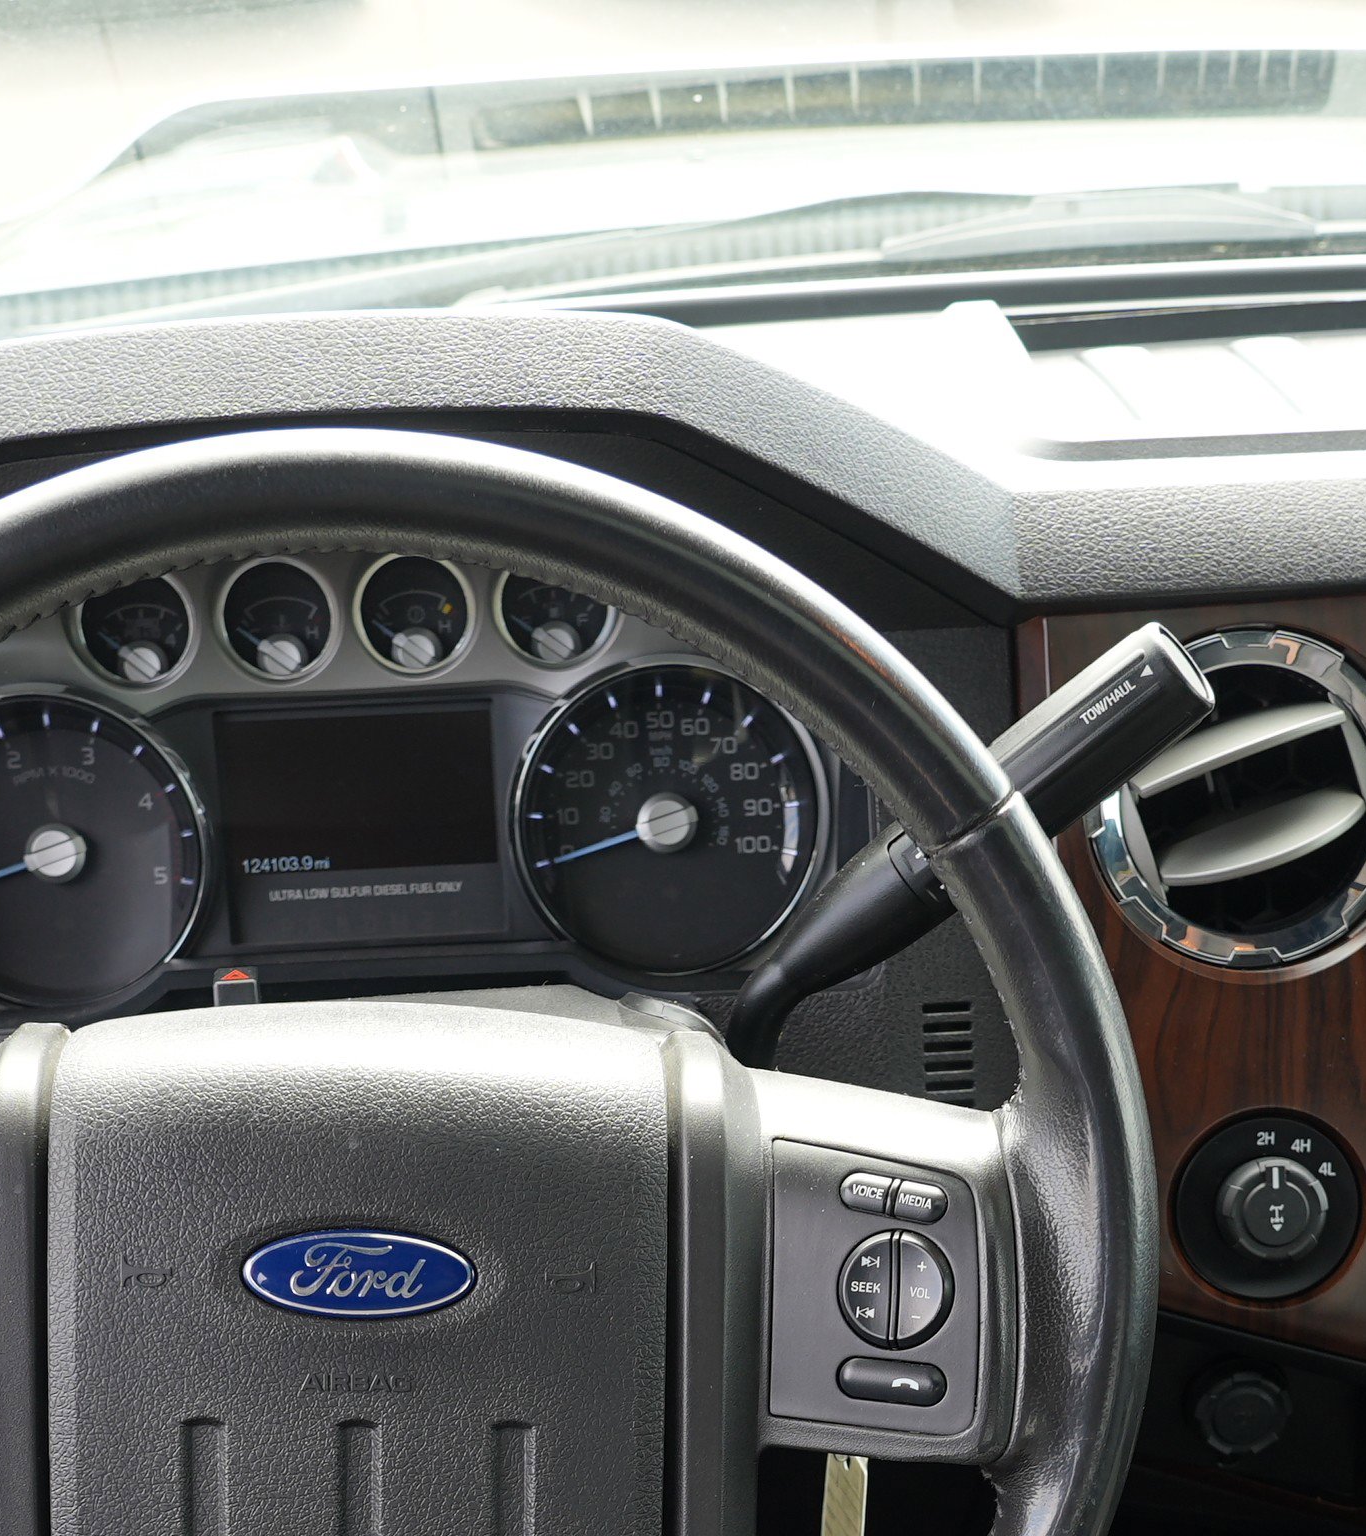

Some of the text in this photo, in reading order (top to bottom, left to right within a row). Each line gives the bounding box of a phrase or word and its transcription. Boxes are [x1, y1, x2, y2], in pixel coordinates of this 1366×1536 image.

[305, 626, 319, 640] H
[438, 619, 452, 633] H
[1079, 679, 1137, 725] TOW/HAUL
[646, 711, 675, 729] 50
[680, 717, 710, 736] 60
[609, 720, 639, 739] 40
[586, 742, 614, 760] 30
[710, 737, 737, 755] 70
[6, 752, 22, 768] 2
[81, 748, 95, 765] 3
[13, 767, 45, 785] RPM
[60, 765, 96, 785] 1000
[565, 771, 595, 788] 20
[730, 762, 760, 780] 80
[138, 793, 154, 811] 4
[743, 799, 773, 817] 90
[557, 808, 579, 825] 10
[735, 836, 771, 854] 100
[153, 866, 168, 885] 5
[268, 880, 463, 902] ULTRA LOW SULFUR DIESEL FUEL ONLY
[1256, 1131, 1275, 1146] 2H
[1290, 1138, 1311, 1153] 4H
[1318, 1162, 1336, 1177] 4L
[852, 1183, 884, 1200] VOICE
[898, 1192, 932, 1210] MEDIA
[290, 1241, 427, 1299] Ford
[850, 1281, 881, 1294] SEEK
[909, 1286, 931, 1300] VOL
[299, 1371, 414, 1393] AIRBAG
